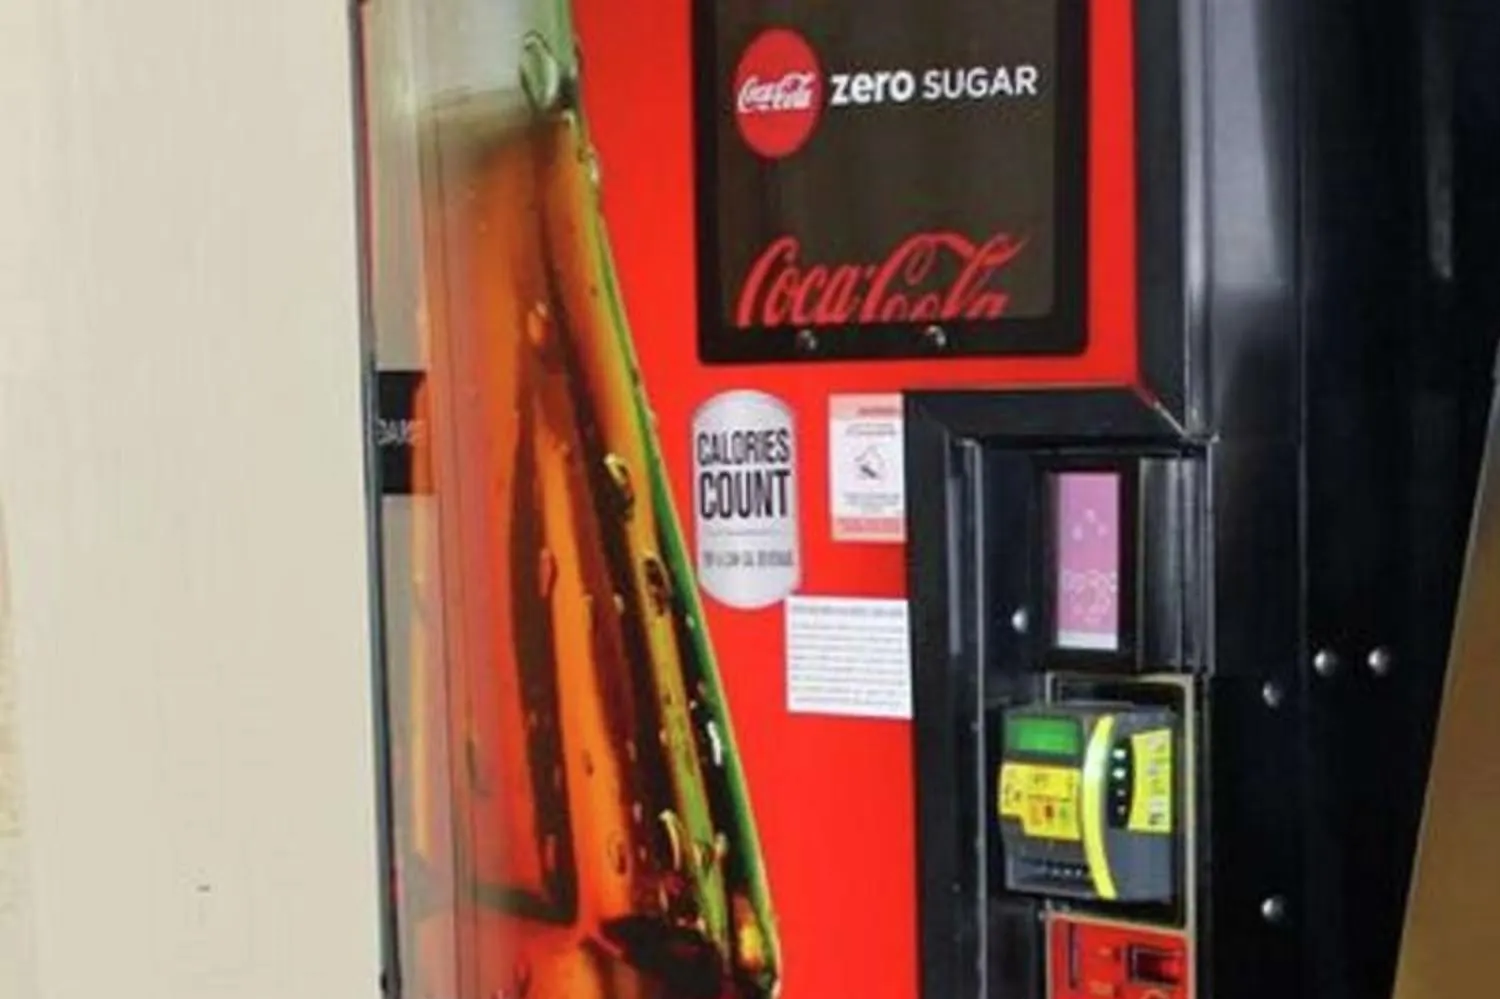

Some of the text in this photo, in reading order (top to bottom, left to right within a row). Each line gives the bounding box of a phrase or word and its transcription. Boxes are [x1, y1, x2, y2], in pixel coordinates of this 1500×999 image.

[830, 69, 916, 107] zero
[922, 65, 1039, 100] SUGAR
[697, 428, 790, 466] CALORIES
[699, 469, 790, 520] COUNT
